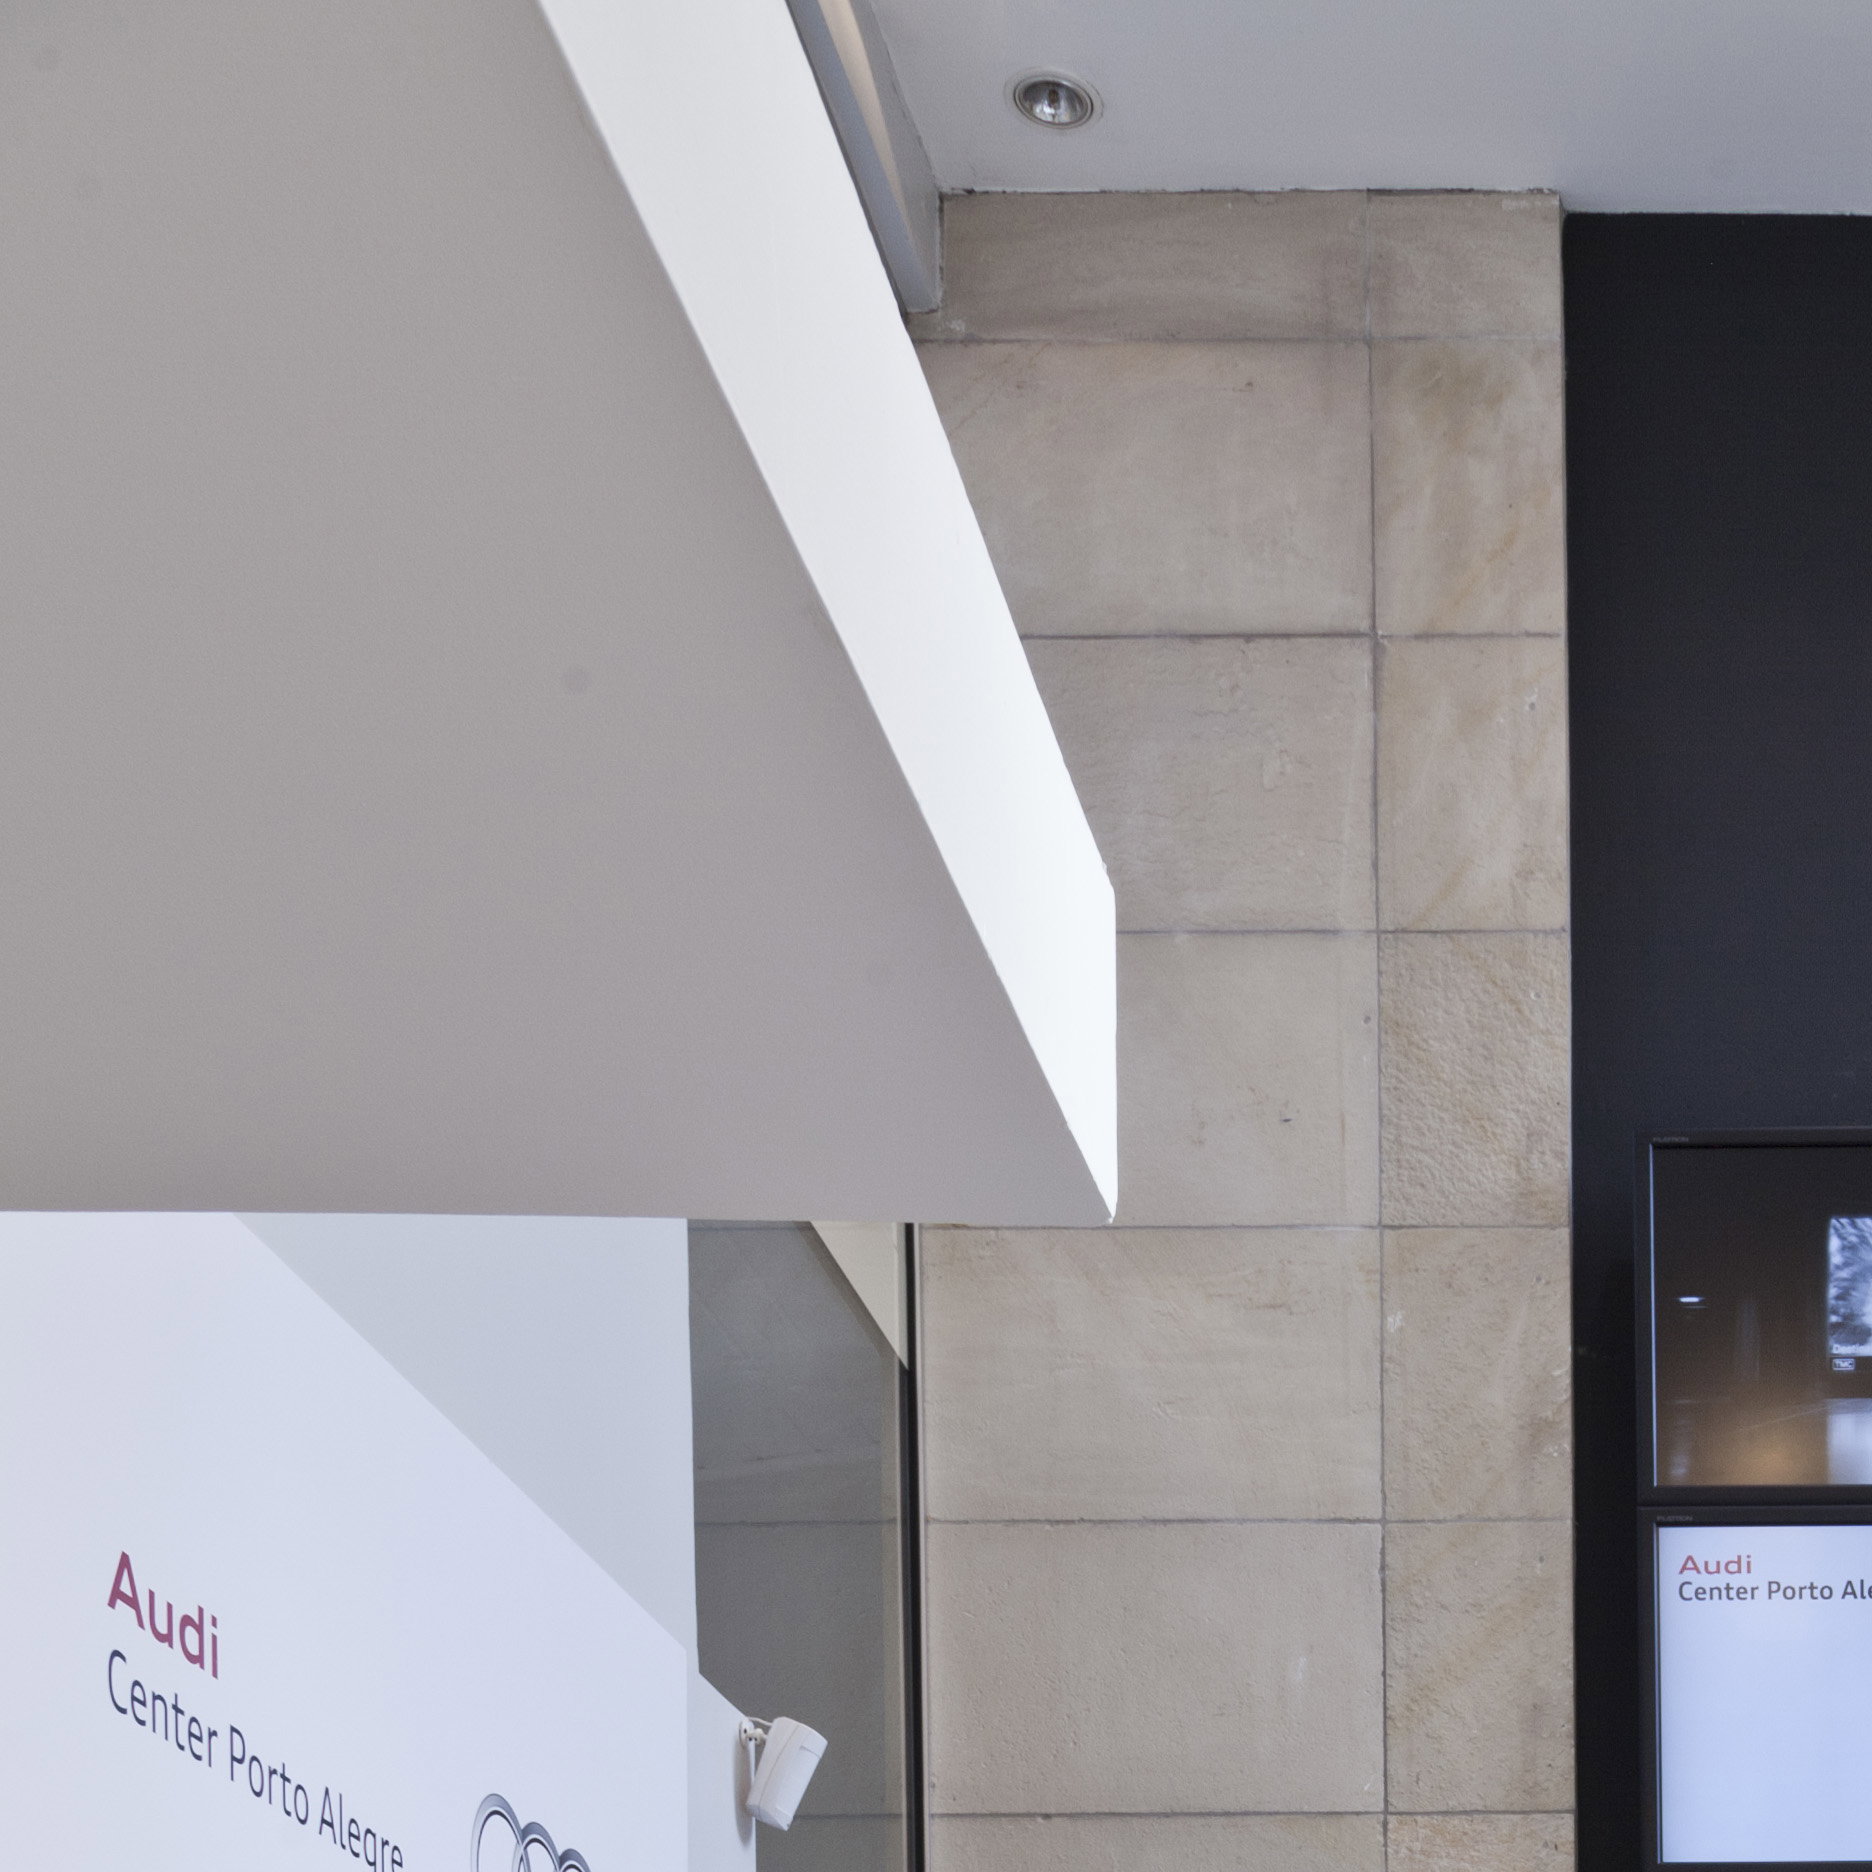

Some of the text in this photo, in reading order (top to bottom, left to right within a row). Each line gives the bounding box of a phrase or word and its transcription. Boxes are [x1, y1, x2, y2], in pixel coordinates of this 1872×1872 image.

[1678, 1554, 1752, 1575] Audi
[1678, 1580, 1759, 1602] Center
[1767, 1580, 1834, 1601] Porto
[107, 1550, 219, 1680] Audi
[108, 1649, 219, 1768] Center
[229, 1724, 309, 1826] Porto
